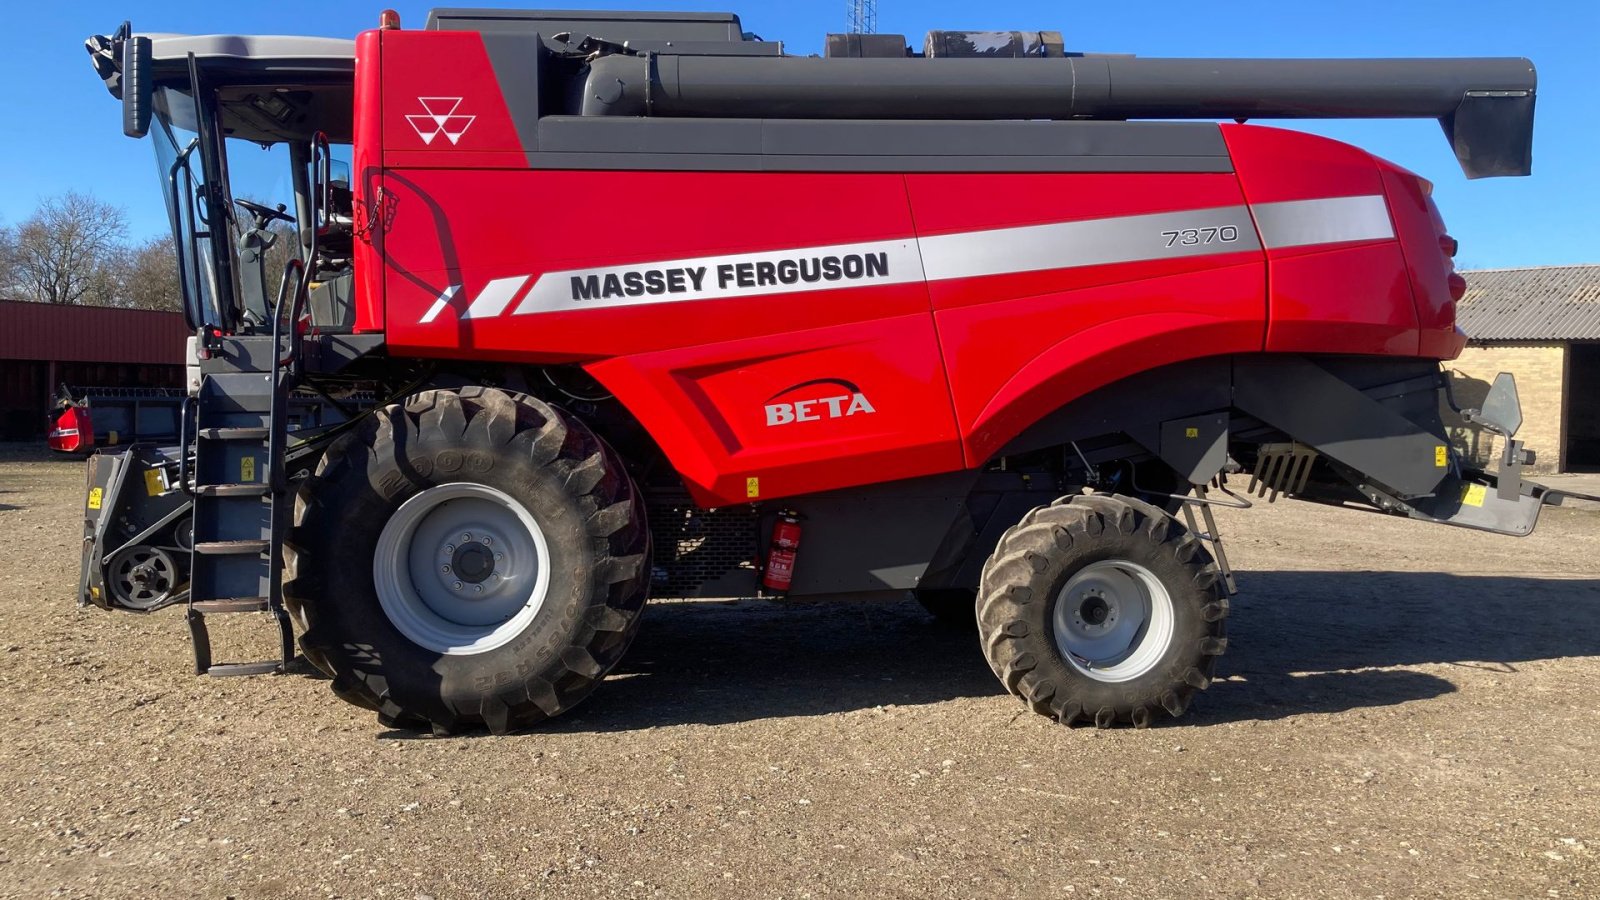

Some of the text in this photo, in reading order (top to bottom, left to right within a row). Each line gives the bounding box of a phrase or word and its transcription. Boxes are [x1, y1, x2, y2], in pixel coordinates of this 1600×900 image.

[1161, 225, 1239, 248] 7370
[570, 252, 889, 301] MASSEY FERGUSON
[764, 393, 877, 426] BETA
